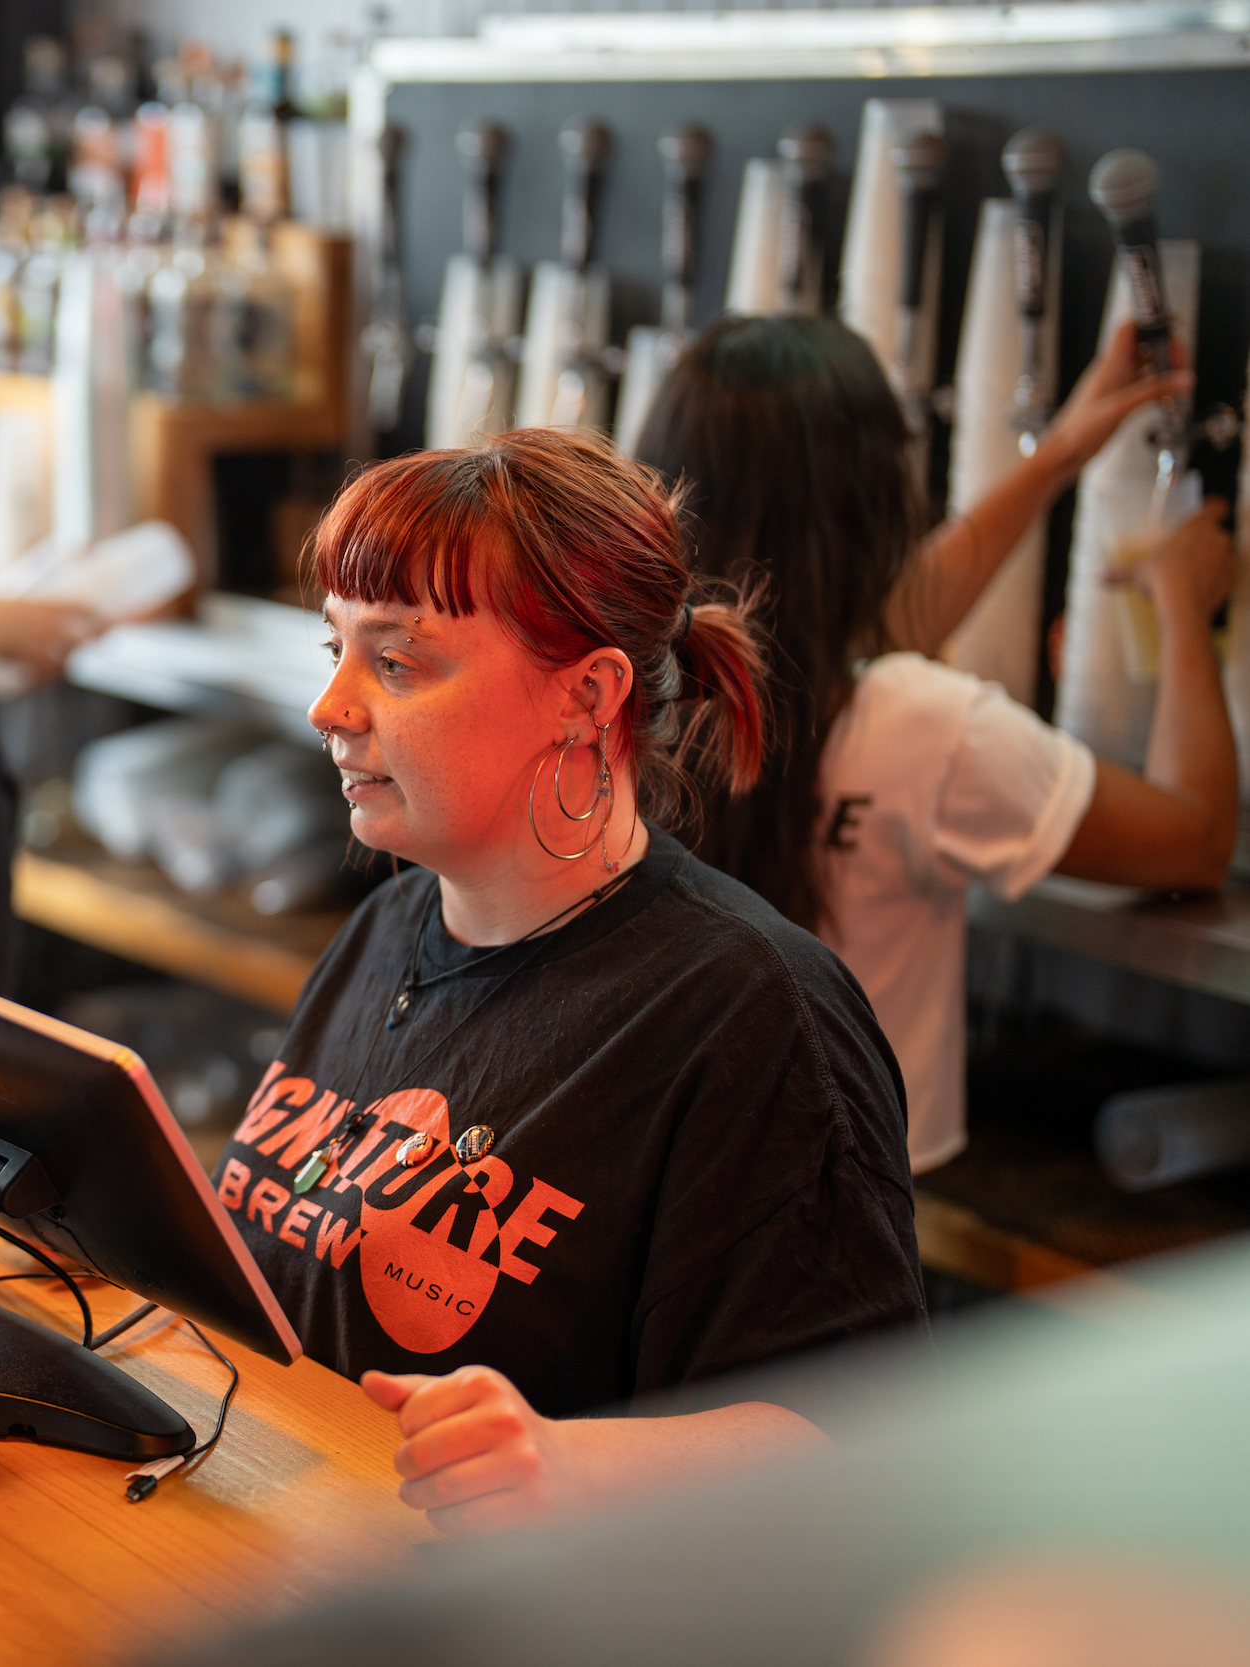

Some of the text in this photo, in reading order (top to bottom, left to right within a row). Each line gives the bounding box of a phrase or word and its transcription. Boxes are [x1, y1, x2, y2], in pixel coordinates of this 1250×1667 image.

[217, 1157, 368, 1270] BREW
[233, 1060, 585, 1286] IGNATURE
[384, 1262, 475, 1316] MUSIC
